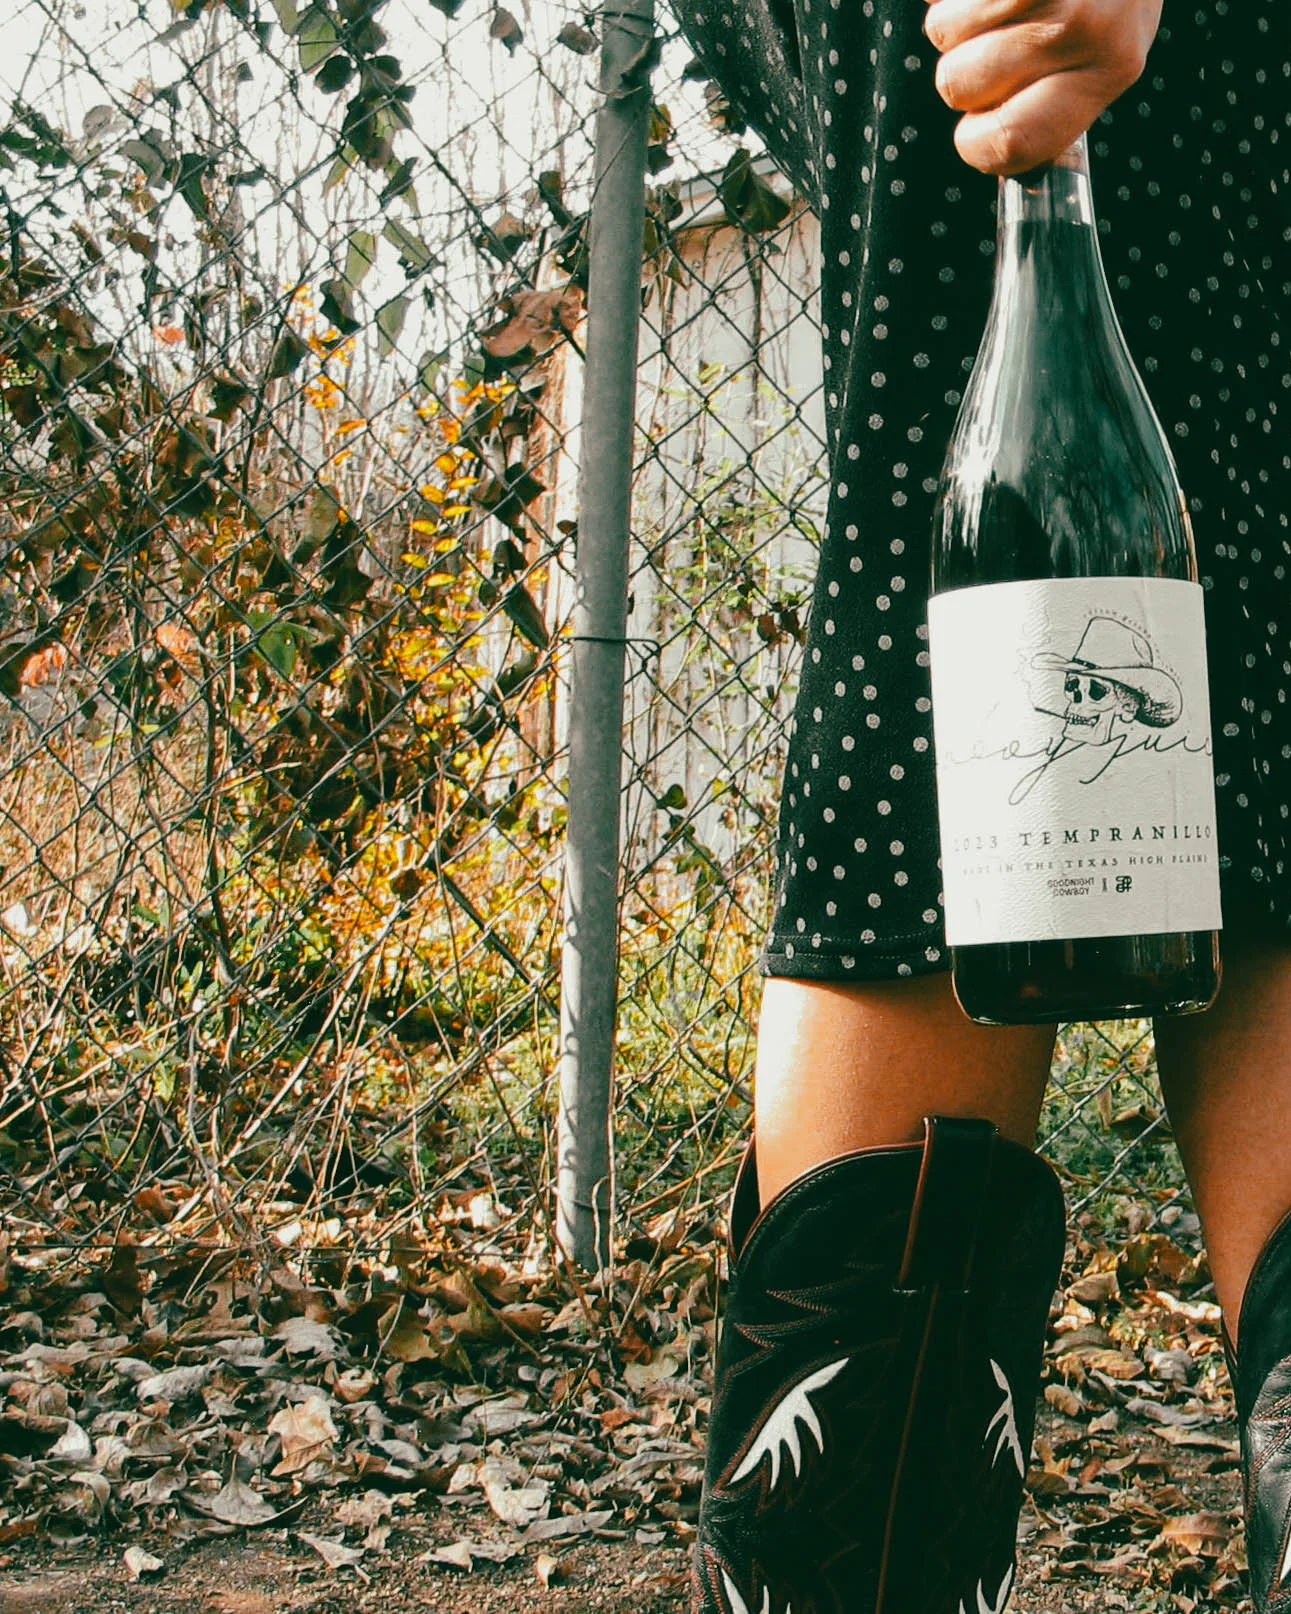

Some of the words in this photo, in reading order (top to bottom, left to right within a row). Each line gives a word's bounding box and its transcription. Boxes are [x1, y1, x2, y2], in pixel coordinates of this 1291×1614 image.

[1019, 825, 1212, 847] TEMPRANILLO
[1065, 857, 1119, 869] TEXAS
[1129, 855, 1164, 866] HIGH
[1047, 876, 1095, 889] GOODNIGHT
[1052, 887, 1090, 897] COWBOY
